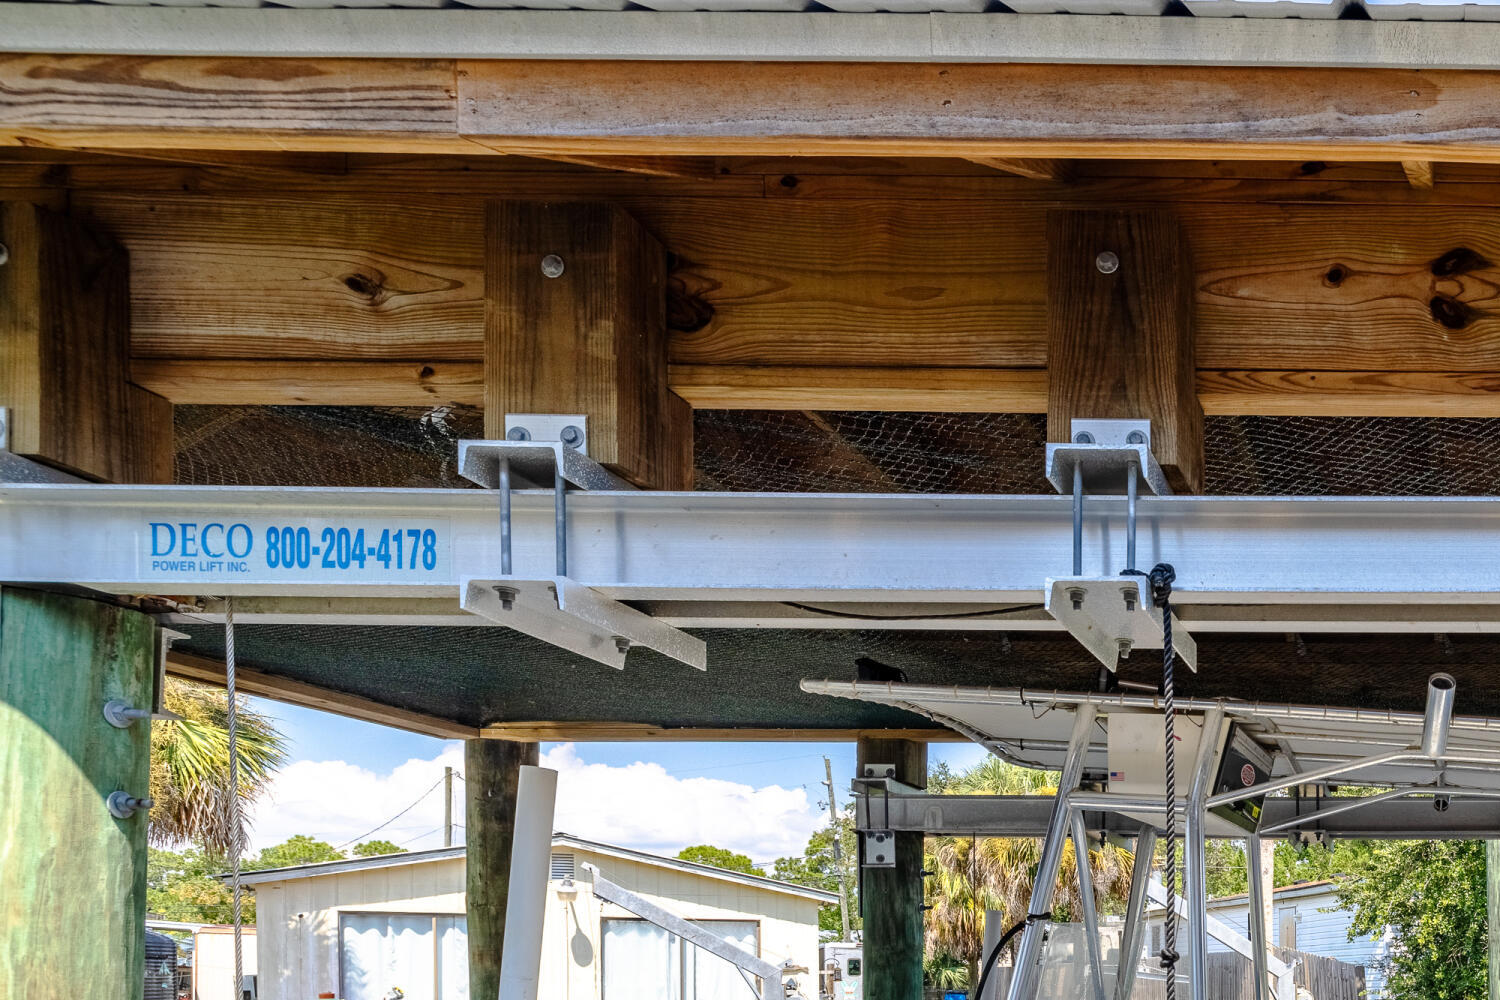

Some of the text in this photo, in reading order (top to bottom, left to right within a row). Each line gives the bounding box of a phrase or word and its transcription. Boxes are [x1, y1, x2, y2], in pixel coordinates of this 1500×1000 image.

[149, 522, 437, 571] DECO 800-204-4178
[152, 561, 251, 573] POWER LIFT INC.
